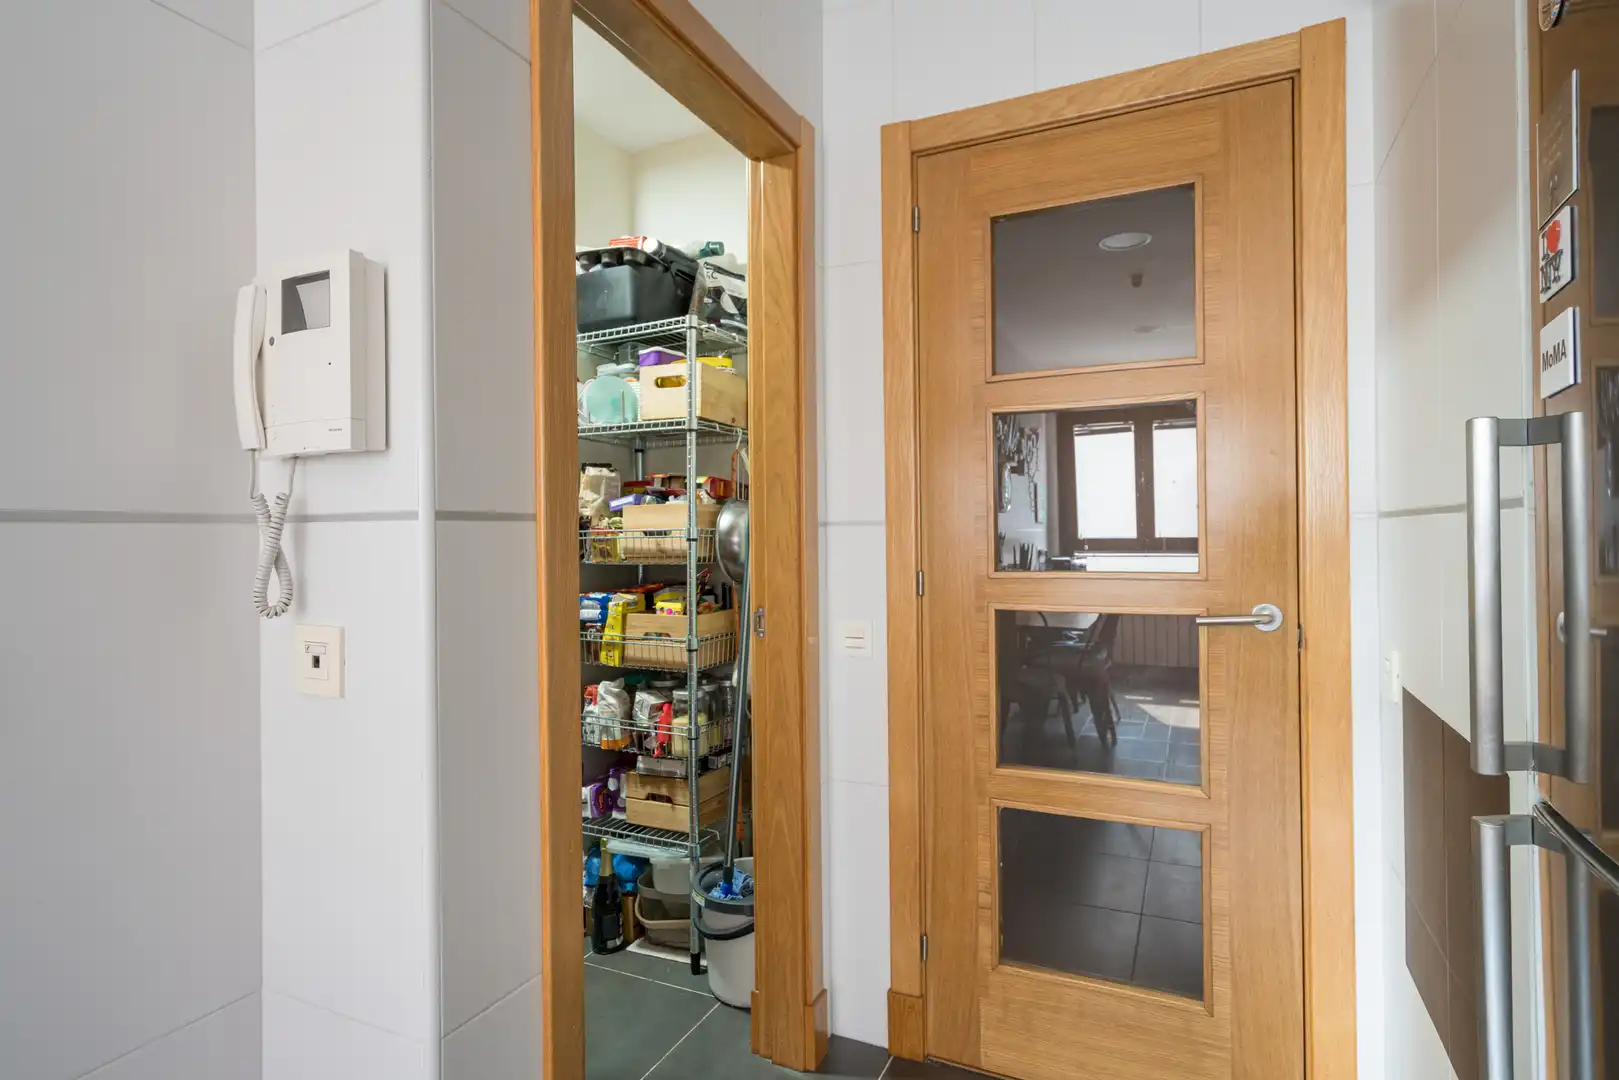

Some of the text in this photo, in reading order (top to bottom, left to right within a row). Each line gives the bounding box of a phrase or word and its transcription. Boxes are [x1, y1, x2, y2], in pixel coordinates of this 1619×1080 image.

[1541, 230, 1549, 261] I
[1540, 249, 1563, 294] NY
[1542, 339, 1567, 372] MoMA
